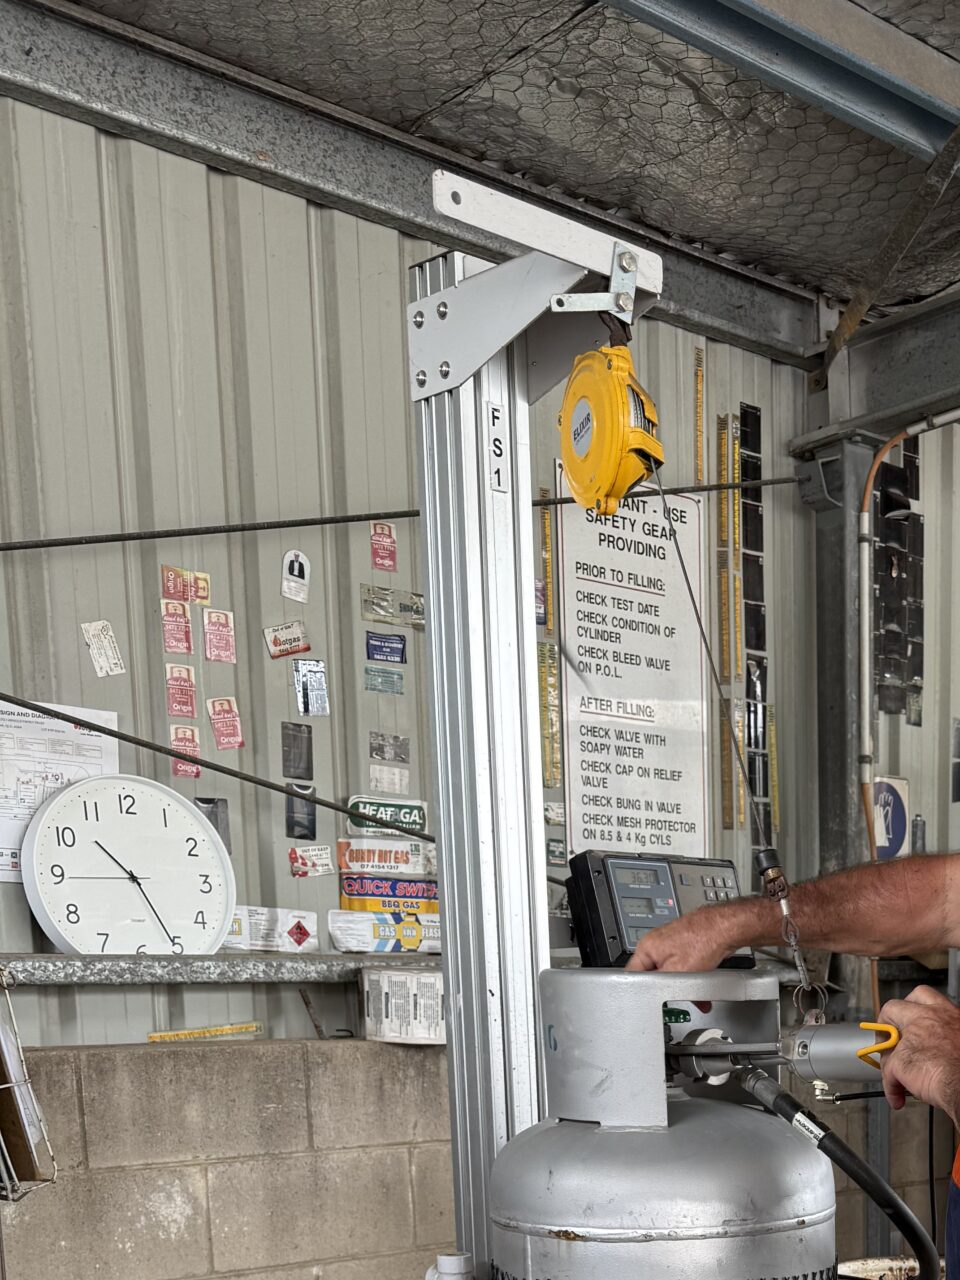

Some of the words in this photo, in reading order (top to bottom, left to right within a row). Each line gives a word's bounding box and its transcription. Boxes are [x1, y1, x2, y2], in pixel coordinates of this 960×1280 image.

[573, 412, 591, 442] ELIXIR
[586, 507, 636, 533] SAFETY
[642, 522, 676, 541] GEAR
[663, 507, 687, 524] USE
[598, 532, 666, 560] PROVIDING
[576, 561, 606, 579] PRIOR
[610, 569, 624, 583] TO
[628, 572, 666, 592] FILLING:
[576, 590, 607, 607] CHECK
[611, 597, 634, 612] TEST
[638, 602, 660, 617] DATE
[577, 610, 608, 626] CHECK
[612, 616, 661, 636] CONDITION
[664, 626, 676, 638] OF
[577, 626, 622, 644] CYLINDER
[577, 645, 609, 661] CHECK
[613, 651, 642, 666] BLEED
[645, 656, 671, 671] VALVE
[578, 661, 592, 674] ON
[595, 663, 622, 679] P.O.L.
[580, 696, 613, 712] AFTER
[617, 701, 655, 718] FILLING:
[580, 725, 611, 740] CHECK
[614, 729, 641, 743] VALVE
[643, 732, 666, 747] WITH
[580, 740, 611, 755] SOAPY
[614, 745, 644, 759] WATER
[580, 760, 612, 774] CHECK
[615, 763, 634, 776] CAP
[637, 766, 650, 779] ON
[653, 768, 683, 782] RELIEF
[581, 775, 608, 789] VALVE
[83, 801, 99, 822] 11
[118, 794, 137, 815] 12
[581, 794, 613, 808] CHECK
[616, 797, 641, 811] BUNG
[644, 800, 653, 812] IN
[656, 802, 682, 815] VALVE
[162, 808, 168, 828] 1
[582, 813, 614, 827] CHECK
[616, 816, 642, 829] MESH
[645, 818, 696, 834] PROTECTOR
[56, 826, 76, 848] 10
[185, 838, 199, 857] 2
[582, 828, 596, 840] ON
[600, 830, 613, 842] 8.5
[616, 831, 623, 842] &
[626, 832, 631, 842] 4
[635, 833, 646, 847] Kg
[649, 833, 672, 846] CYLS
[394, 850, 410, 865] GAS
[50, 864, 65, 885] 9
[199, 874, 213, 894] 3
[343, 879, 393, 896] QUICK
[66, 903, 80, 925] 8
[382, 900, 400, 909] BBQ
[403, 901, 420, 909] GAS
[193, 911, 208, 930] 4
[379, 926, 395, 937] GAS
[422, 927, 440, 938] FLAS
[97, 933, 110, 953] 7
[172, 936, 184, 955] 5
